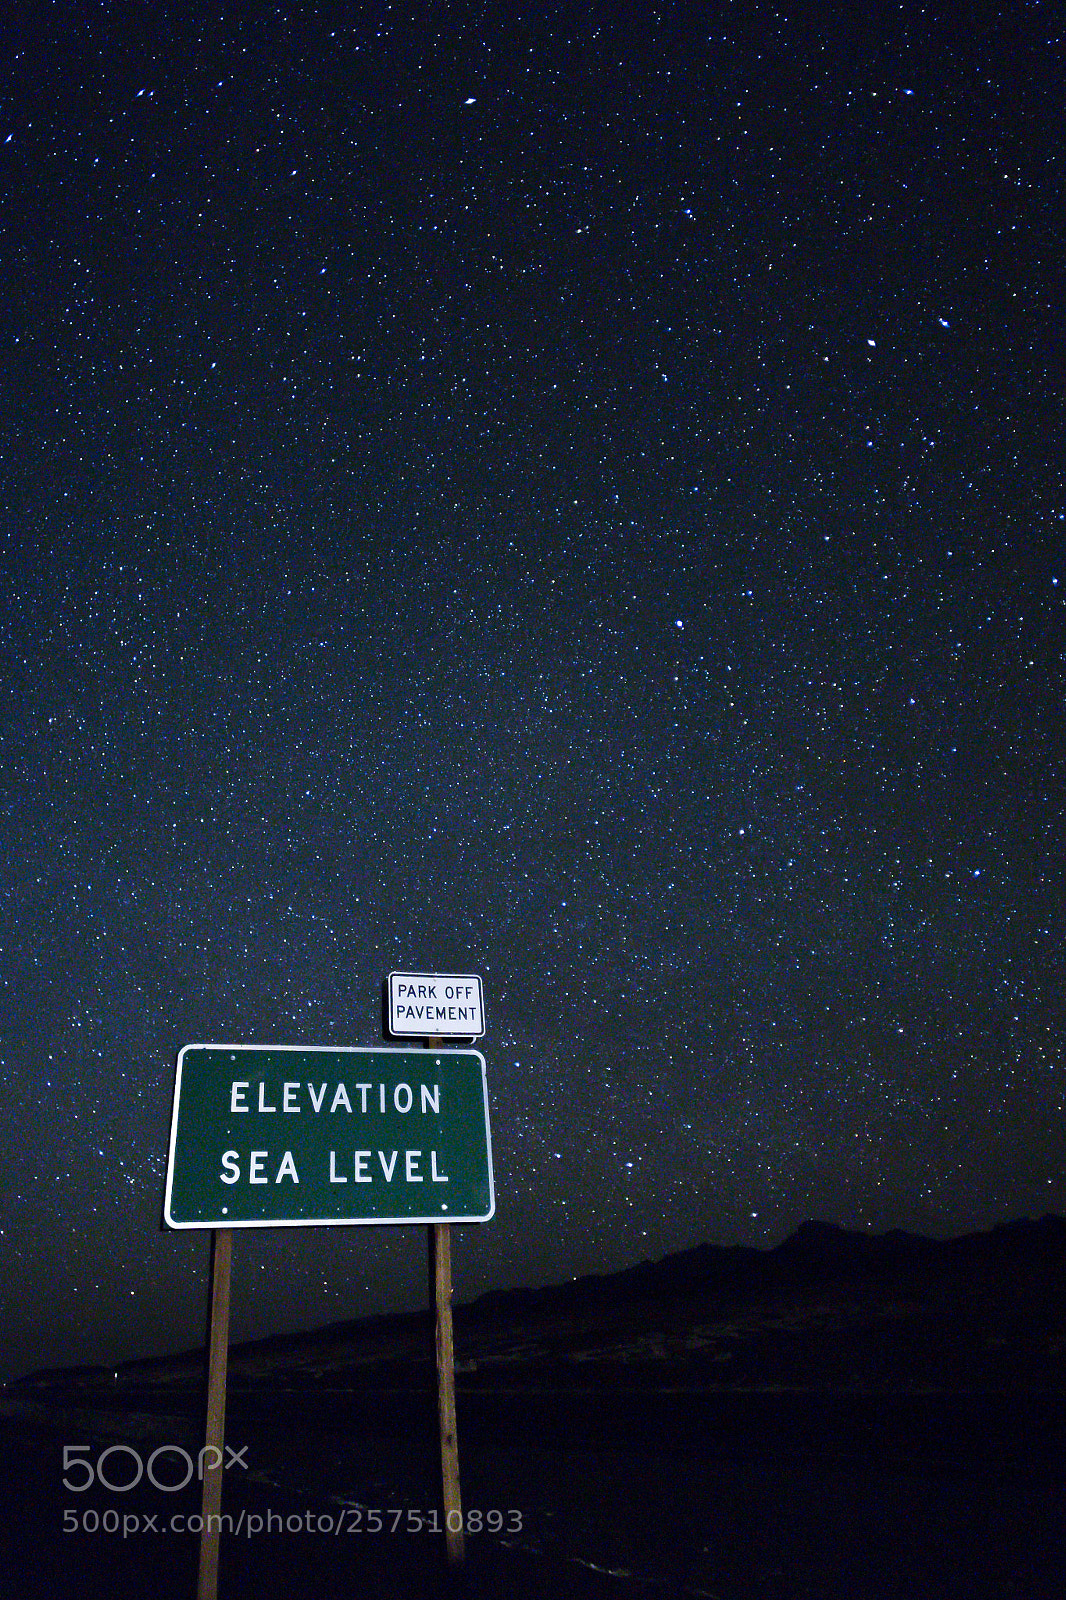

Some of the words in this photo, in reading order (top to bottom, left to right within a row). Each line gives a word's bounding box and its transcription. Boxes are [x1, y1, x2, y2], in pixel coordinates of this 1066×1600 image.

[398, 984, 437, 999] PARK
[445, 986, 473, 999] OFF
[396, 1004, 477, 1020] PAVEMENT
[230, 1081, 440, 1114] ELEVATION
[219, 1150, 299, 1184] SEA
[329, 1151, 449, 1183] LEVEL
